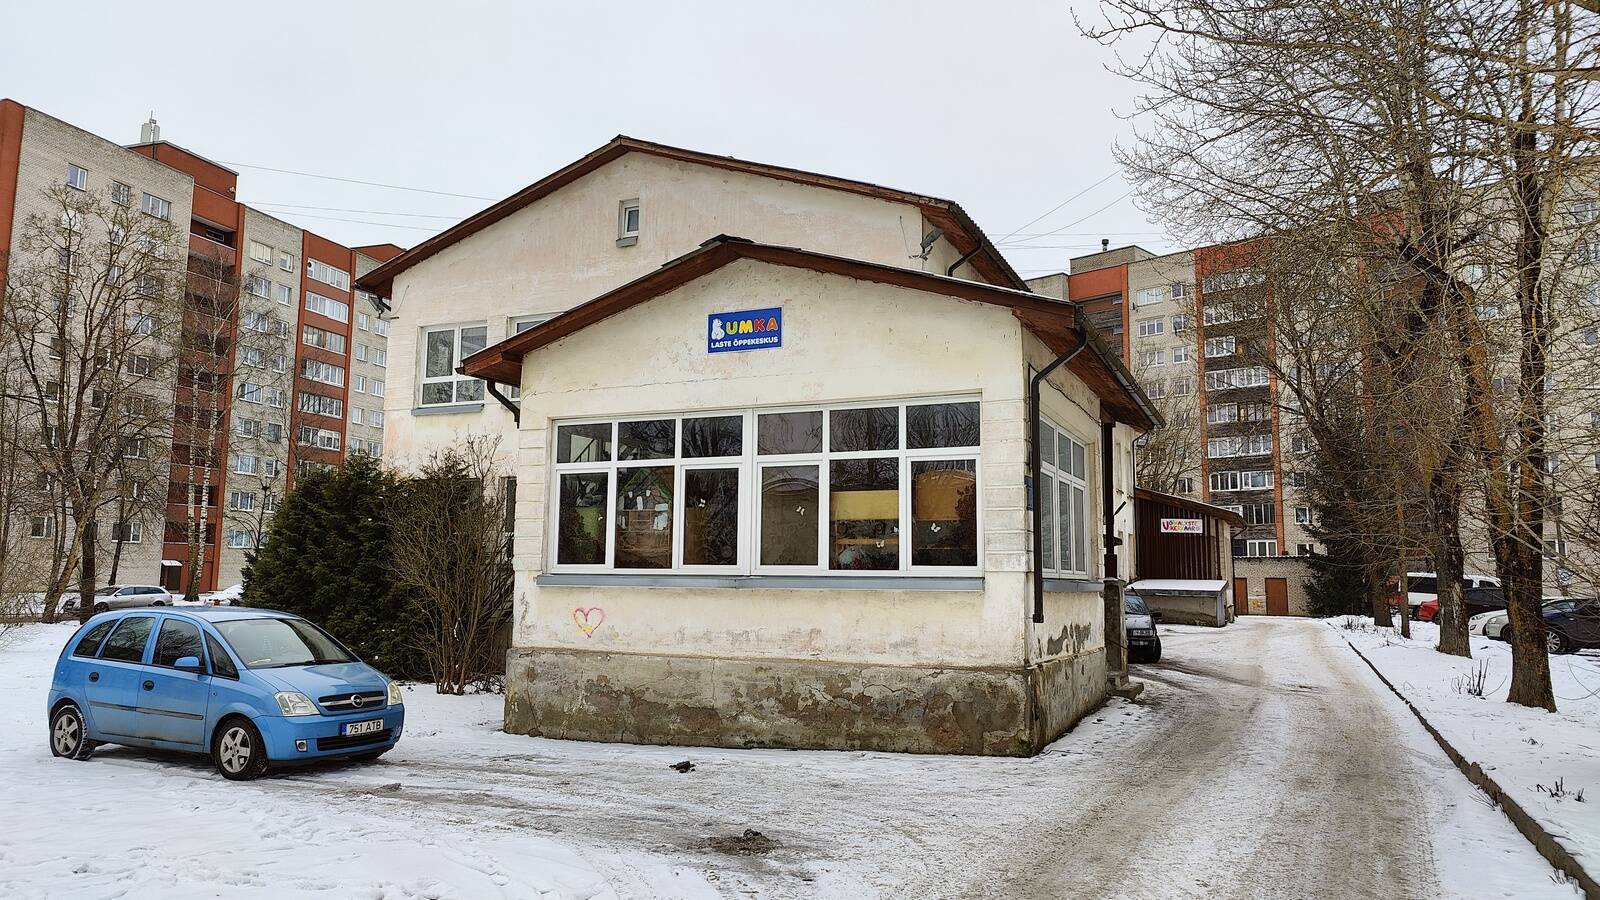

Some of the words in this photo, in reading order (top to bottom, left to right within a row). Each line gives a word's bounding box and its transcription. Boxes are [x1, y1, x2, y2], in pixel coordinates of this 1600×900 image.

[711, 340, 732, 348] LASTE
[733, 336, 778, 347] ÕPPEKESKUS
[349, 723, 363, 734] 751
[366, 720, 381, 731] ATB
